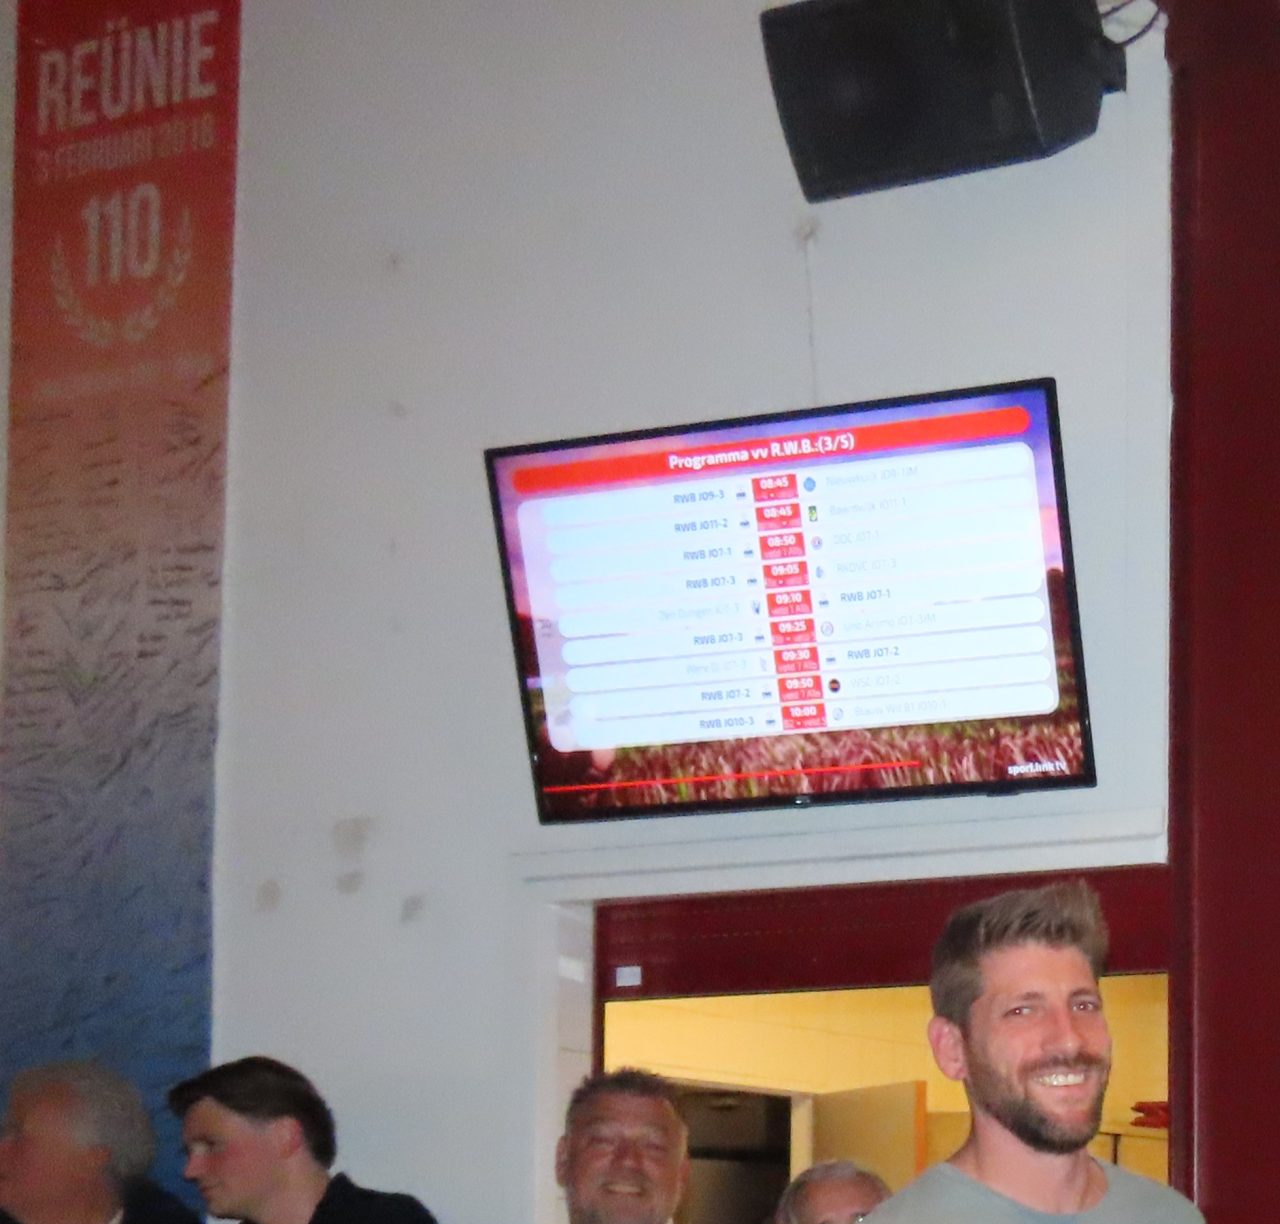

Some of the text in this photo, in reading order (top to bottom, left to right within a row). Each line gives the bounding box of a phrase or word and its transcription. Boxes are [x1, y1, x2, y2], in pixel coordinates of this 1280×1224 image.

[37, 10, 219, 135] REÜNIE
[81, 182, 162, 286] 110
[668, 449, 749, 470] Programma
[751, 447, 769, 460] vv
[840, 591, 864, 602] RWB
[847, 648, 871, 660] RWB
